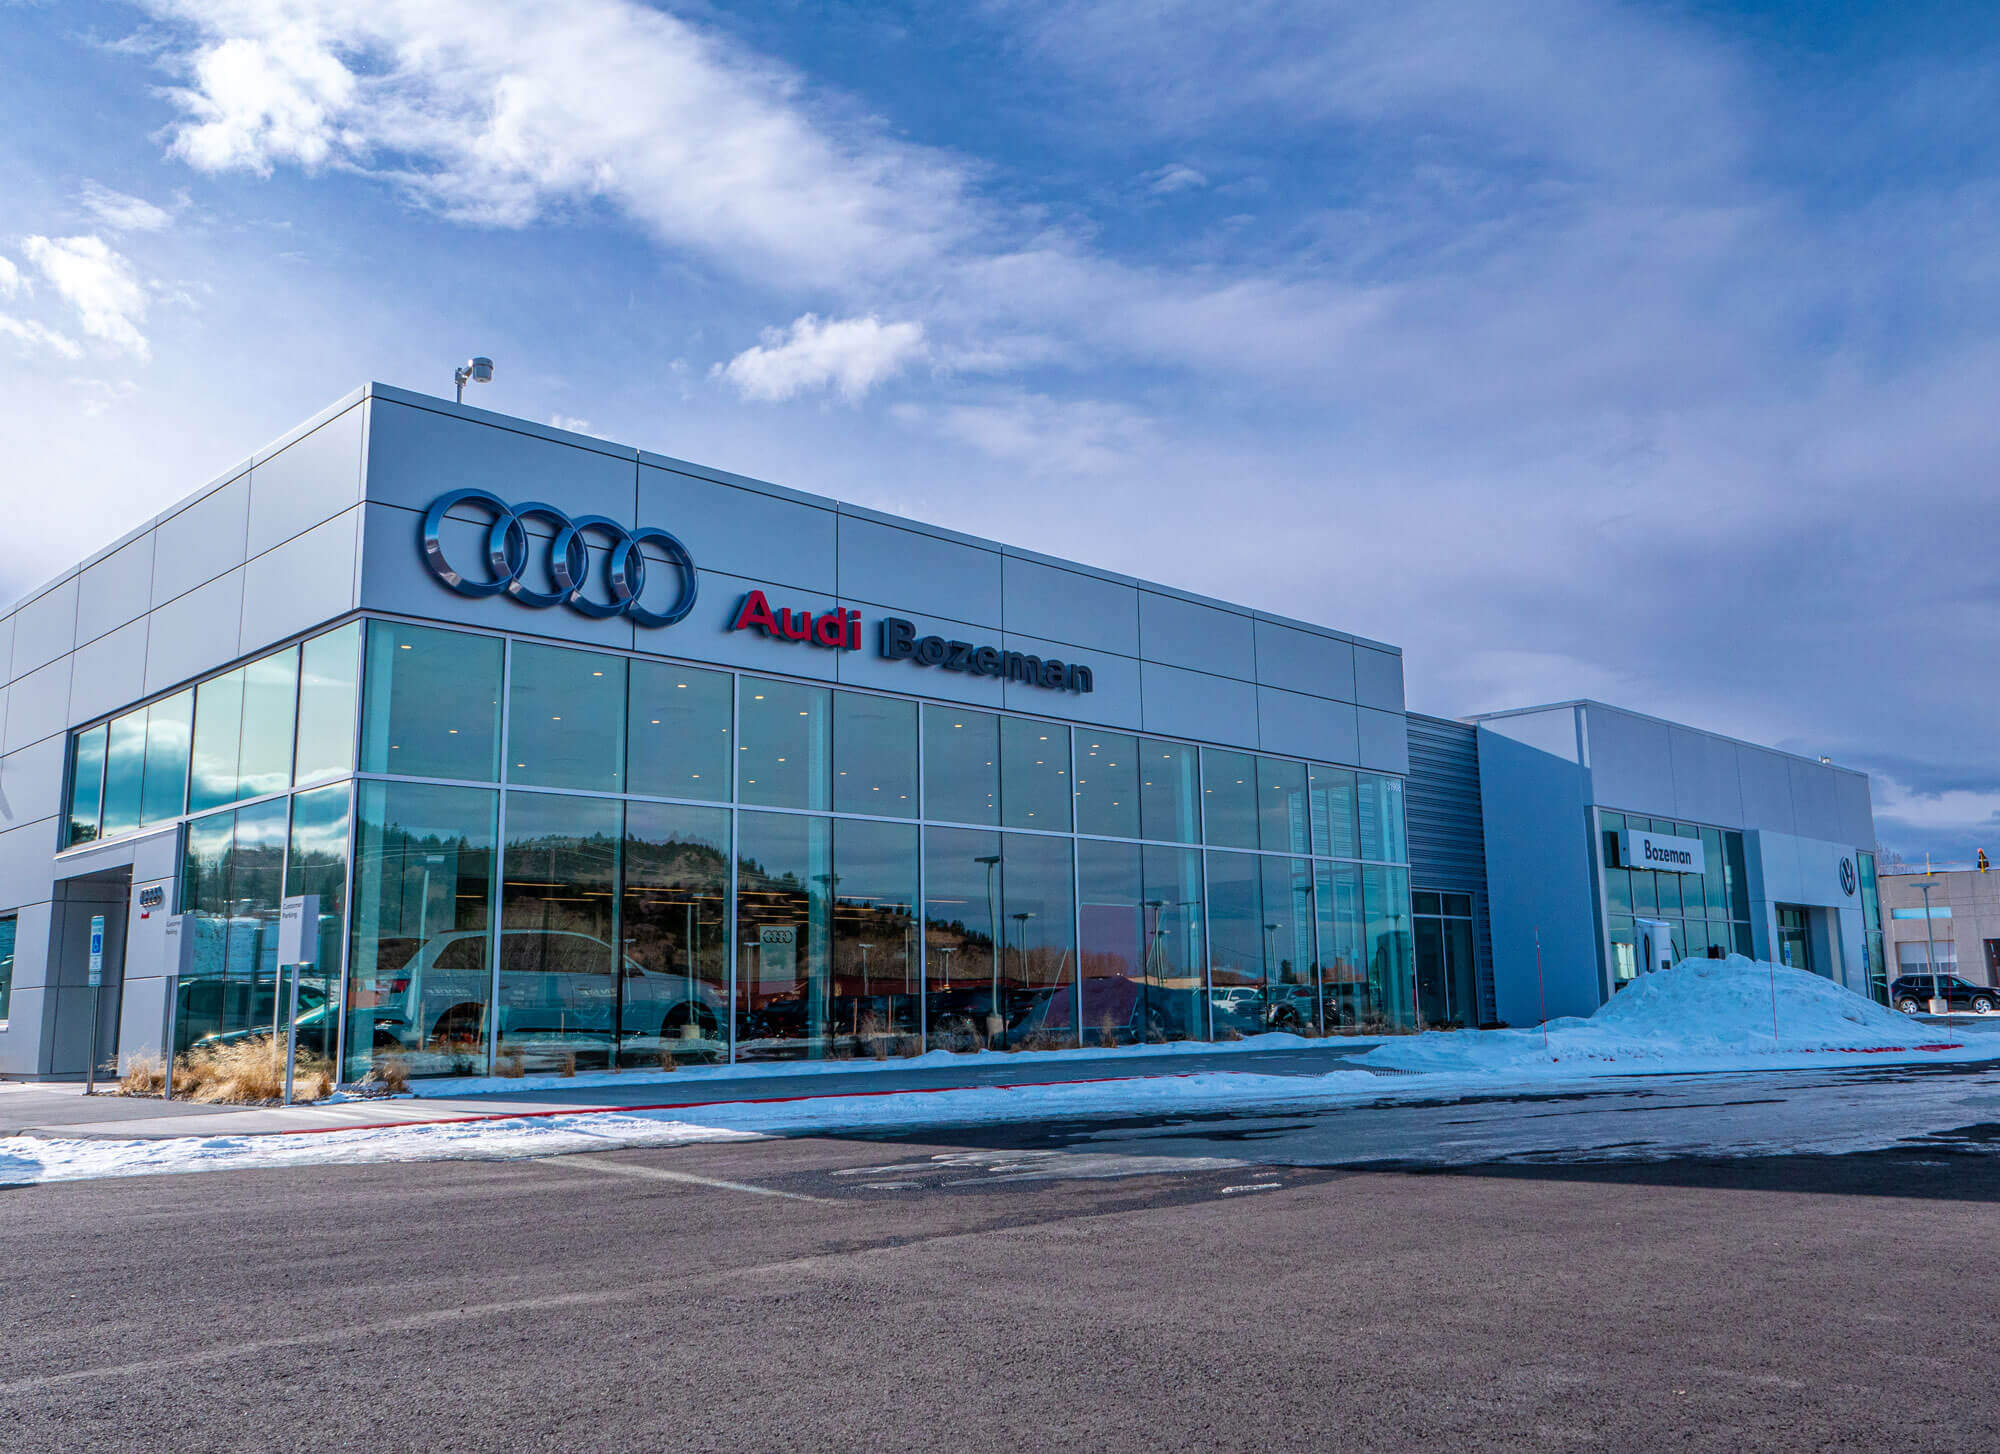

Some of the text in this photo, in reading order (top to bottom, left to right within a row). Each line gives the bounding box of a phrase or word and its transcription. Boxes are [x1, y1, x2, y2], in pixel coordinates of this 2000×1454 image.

[732, 590, 1094, 693] Audi Bozeman
[1643, 839, 1692, 865] Bozeman
